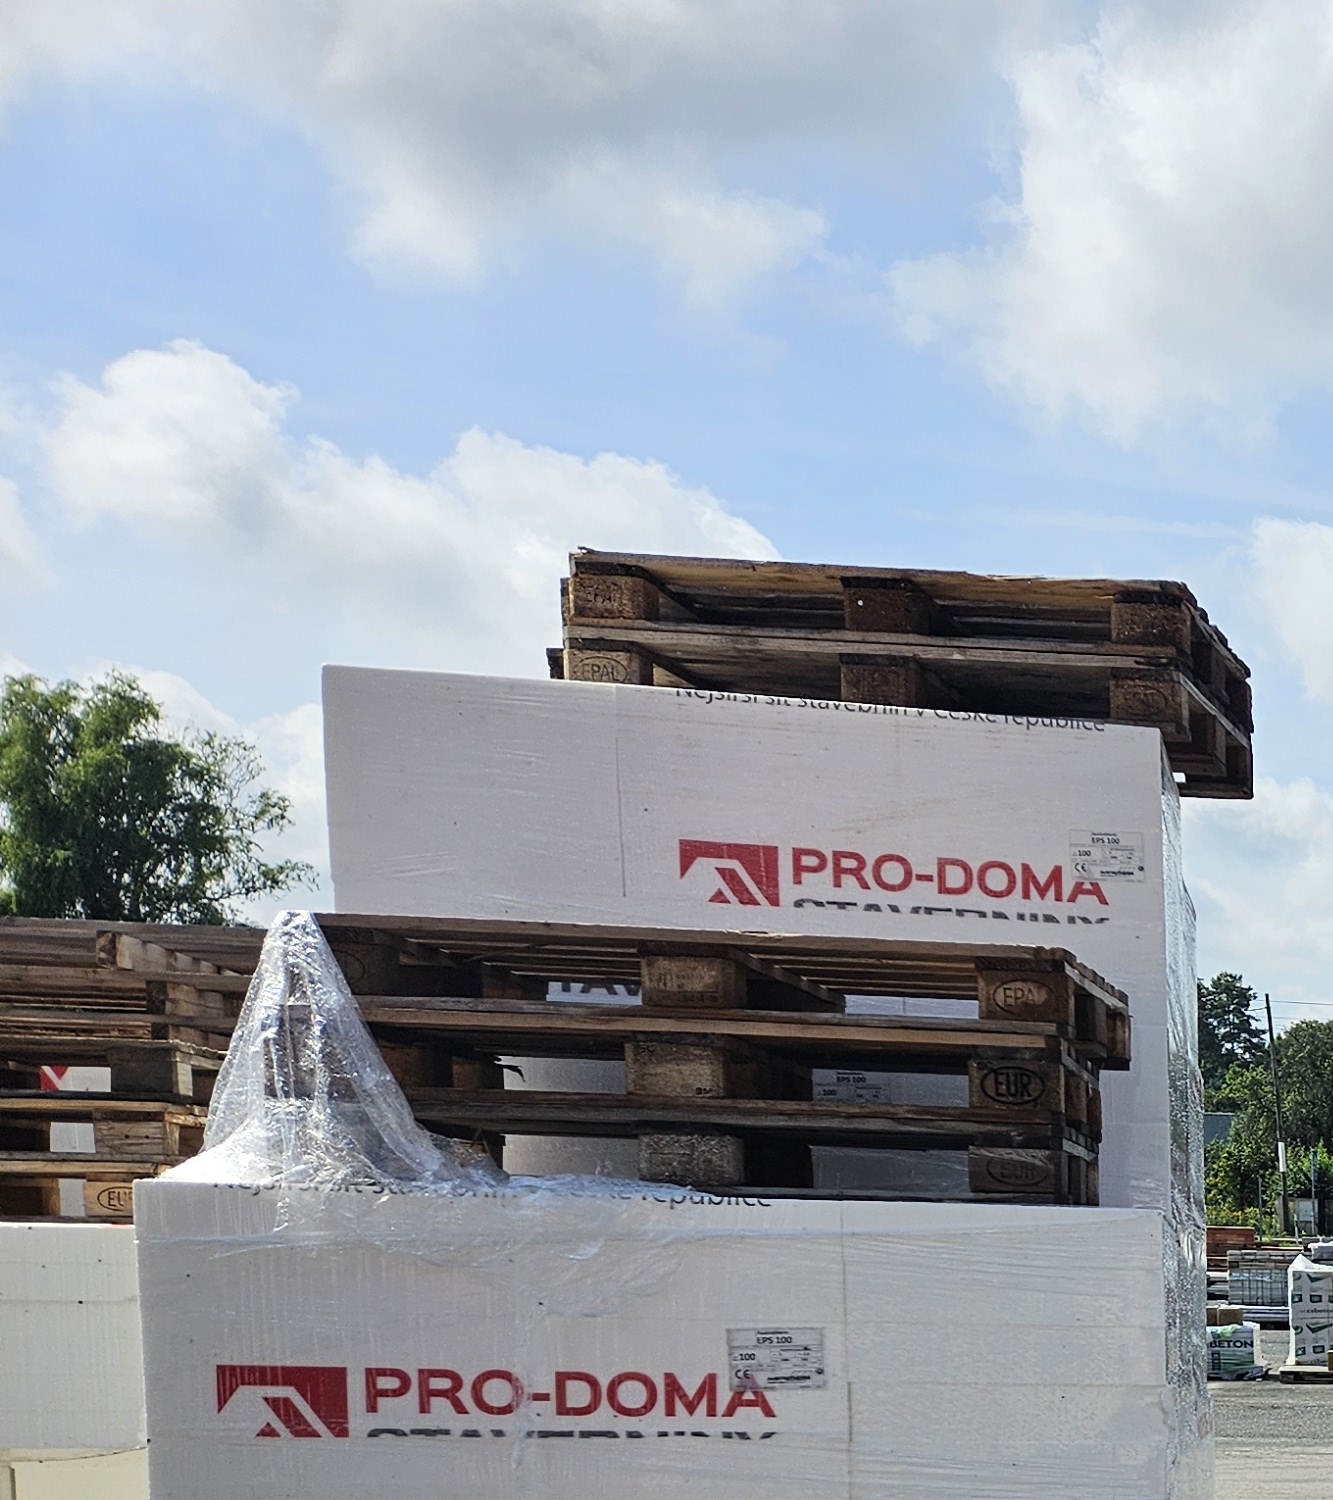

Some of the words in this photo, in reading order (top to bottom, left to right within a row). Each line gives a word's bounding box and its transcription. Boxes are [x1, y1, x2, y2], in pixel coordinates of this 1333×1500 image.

[791, 847, 1109, 906] PRO-DOMA
[993, 1072, 1032, 1099] EUR
[364, 1367, 777, 1418] PRO-DOMA
